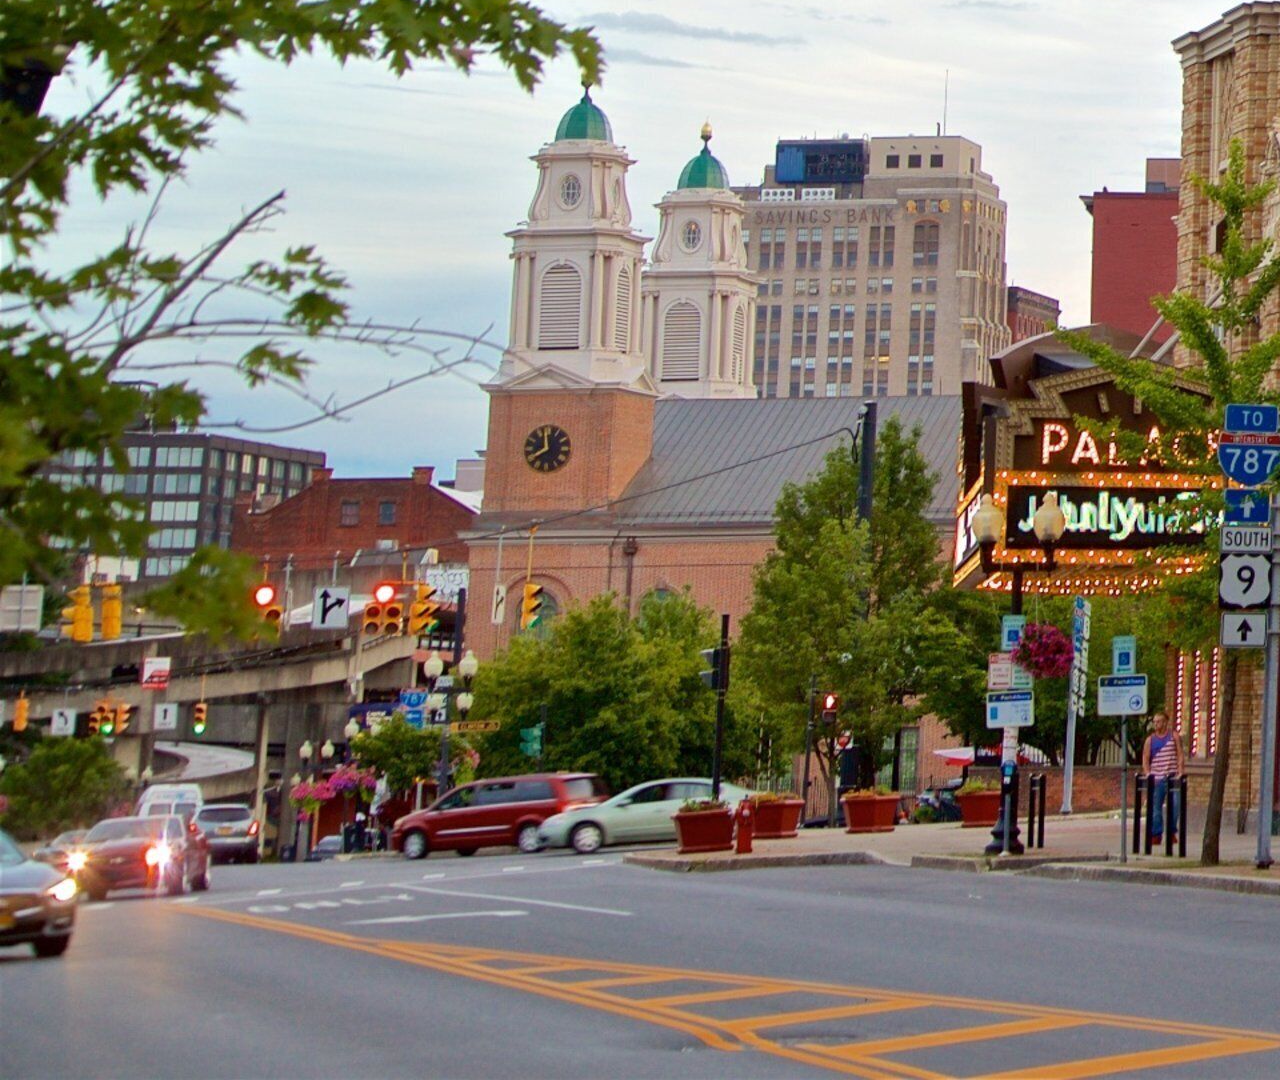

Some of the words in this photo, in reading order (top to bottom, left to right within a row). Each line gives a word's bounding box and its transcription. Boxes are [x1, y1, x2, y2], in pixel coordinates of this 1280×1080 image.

[755, 208, 832, 225] SAVINGS
[847, 208, 894, 224] BANK
[1242, 410, 1263, 426] TO
[1225, 448, 1280, 474] 787
[1225, 531, 1269, 547] SOUTH
[1237, 565, 1255, 594] 9
[403, 694, 427, 704] 787
[247, 893, 414, 913] ONLY
